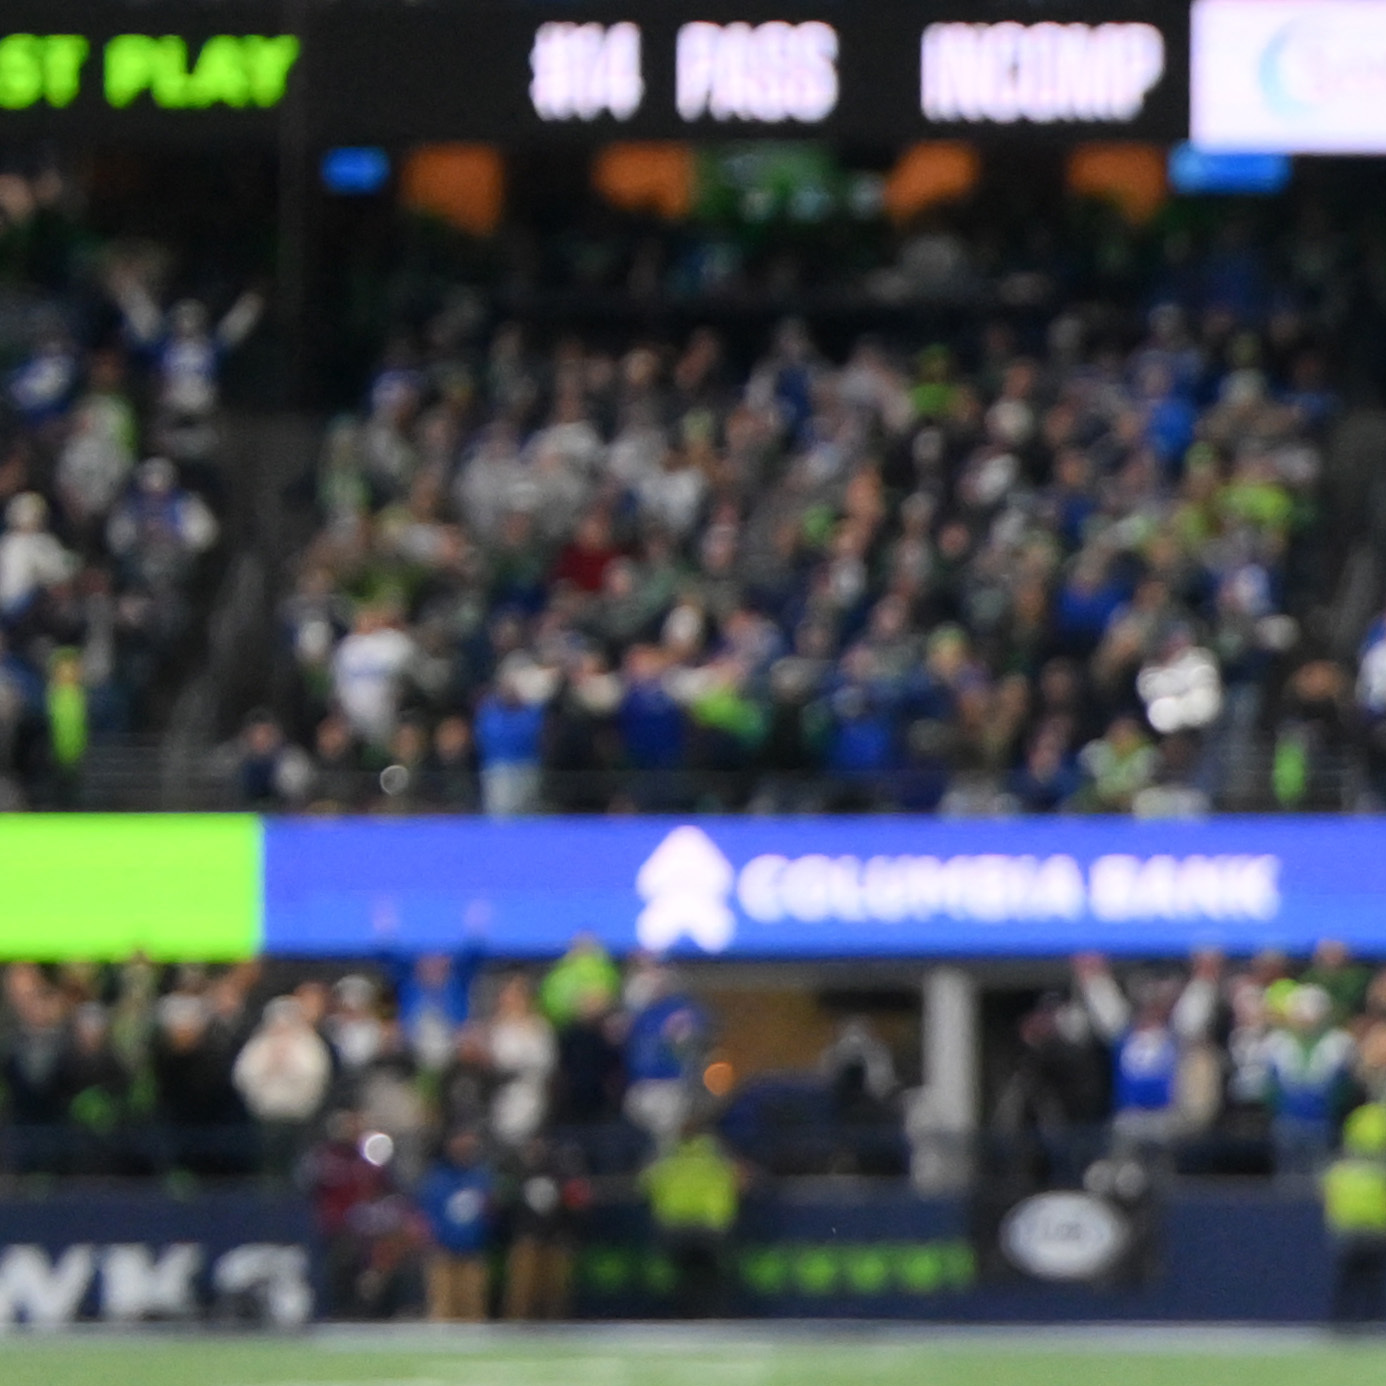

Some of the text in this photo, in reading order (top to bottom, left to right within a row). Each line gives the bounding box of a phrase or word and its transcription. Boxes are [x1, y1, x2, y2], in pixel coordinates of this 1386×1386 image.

[103, 34, 299, 109] PLAY
[676, 21, 839, 122] PASS
[1089, 853, 1281, 923] BANK
